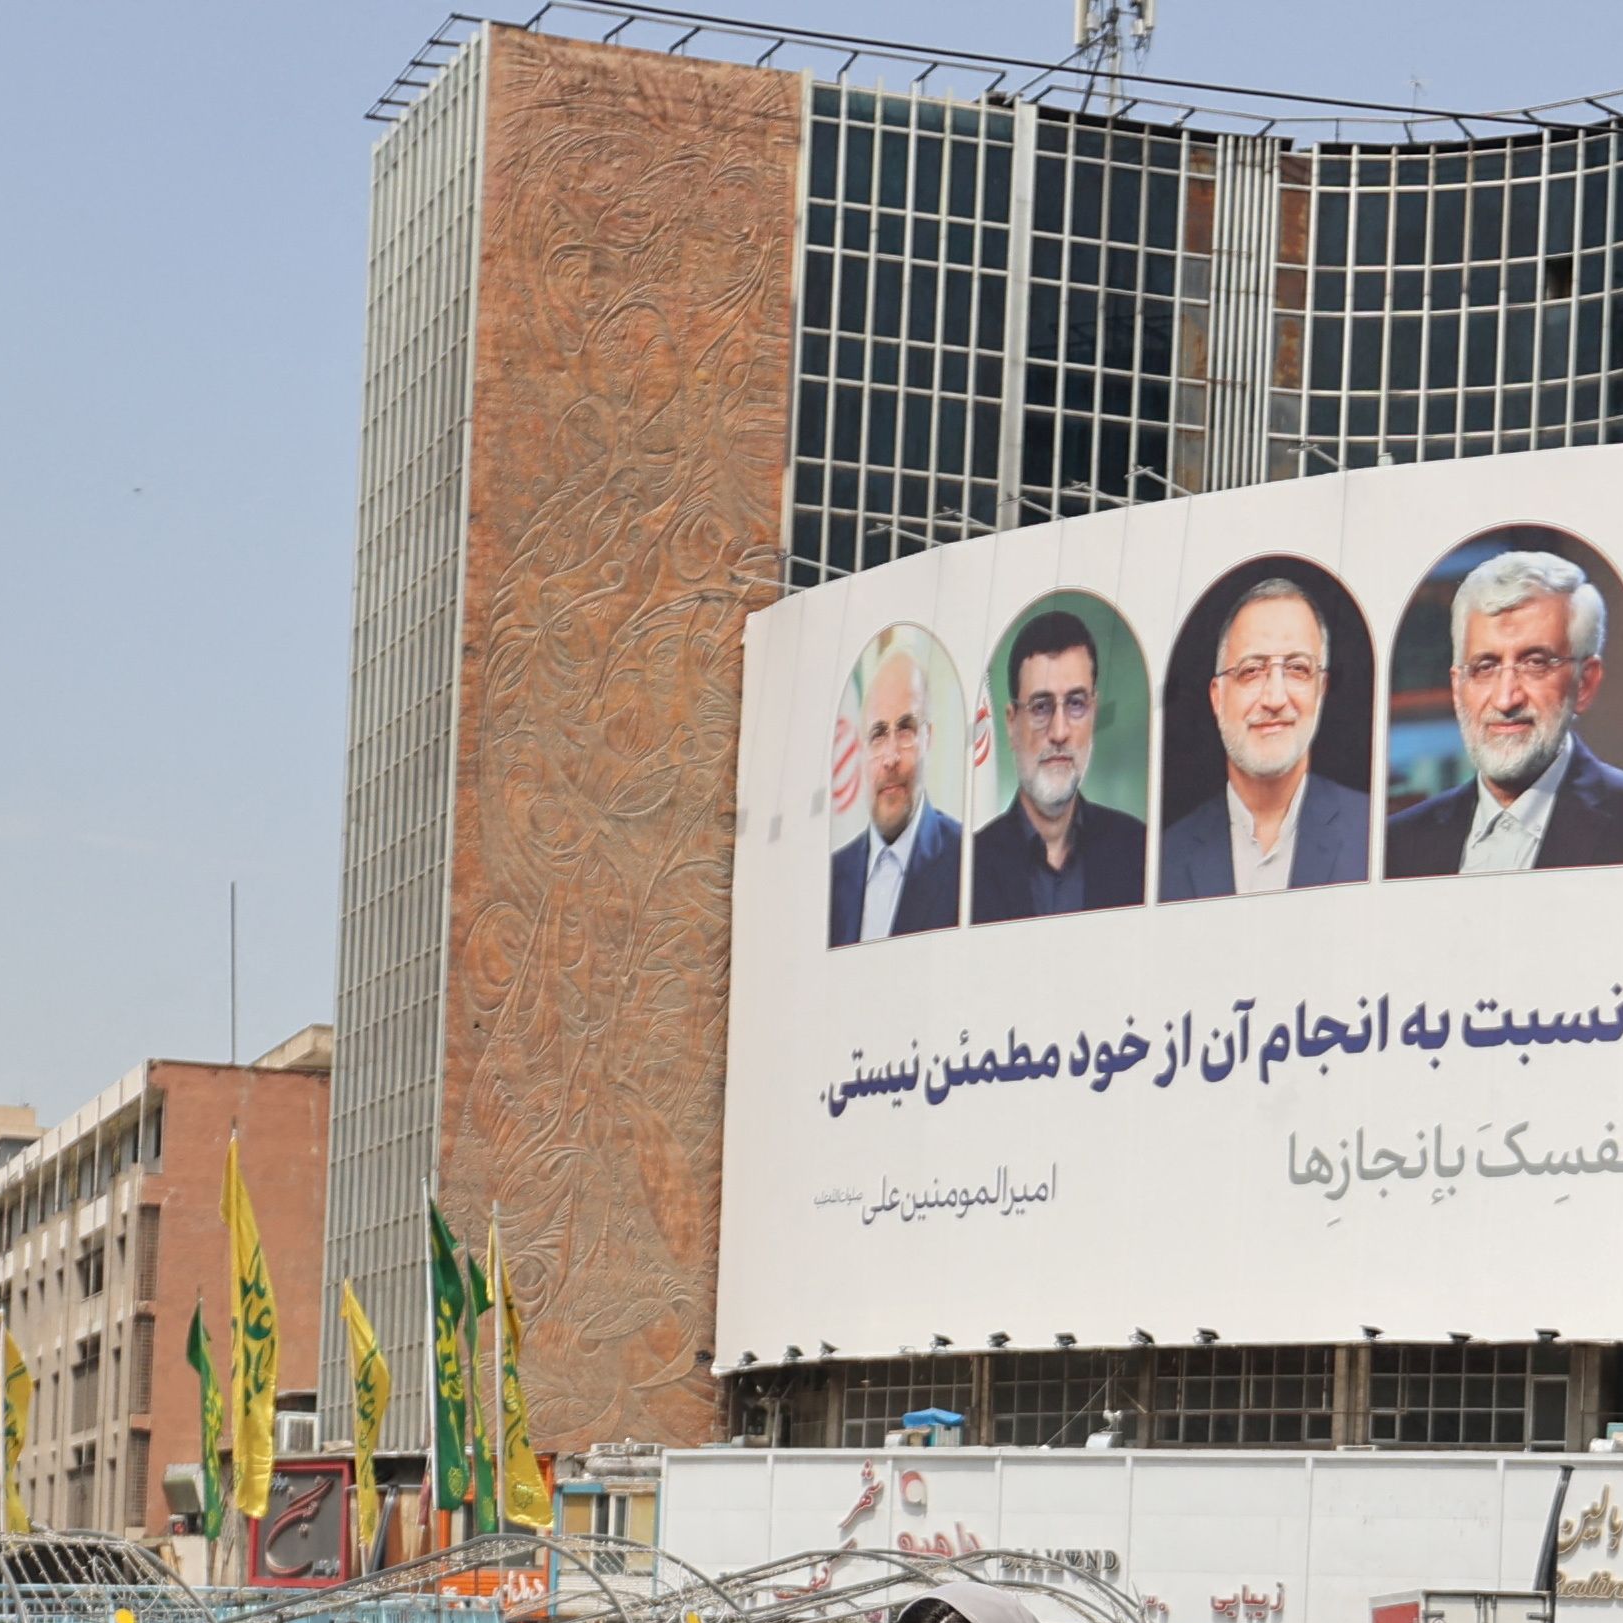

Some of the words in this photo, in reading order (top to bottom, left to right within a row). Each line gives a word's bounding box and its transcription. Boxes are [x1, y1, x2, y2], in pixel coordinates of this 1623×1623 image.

[923, 1025, 1062, 1106] مطمئن
[1067, 1014, 1152, 1092] خود
[1152, 1009, 1193, 1088] از
[1200, 997, 1257, 1083] آن
[1259, 992, 1390, 1085] انجام
[1399, 1005, 1452, 1070] به
[819, 1038, 921, 1118] نیستی.
[861, 1174, 902, 1226] علی
[1210, 1581, 1285, 1617] زیبایی
